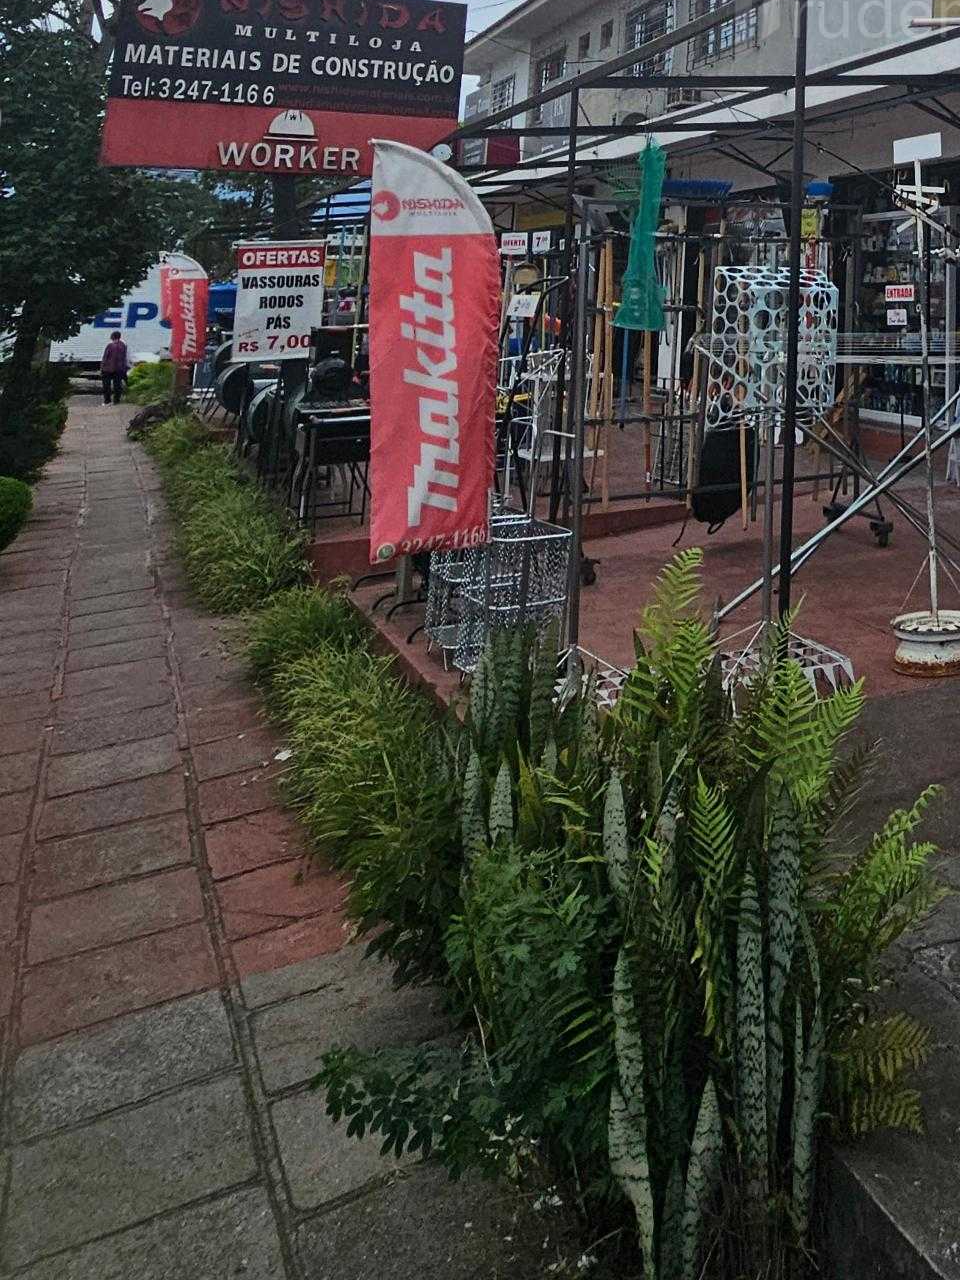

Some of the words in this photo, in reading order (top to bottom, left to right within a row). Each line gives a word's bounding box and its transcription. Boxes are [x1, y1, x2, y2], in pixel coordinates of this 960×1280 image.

[235, 24, 422, 52] MULTILOJA
[124, 43, 261, 71] MATERIAIS
[272, 52, 301, 74] DE
[311, 56, 455, 86] CONSTRUÇÃO
[218, 142, 361, 170] WORKER
[242, 250, 320, 266] OFERTAS
[241, 274, 320, 290] VASSOURAS
[259, 295, 304, 309] RODOS
[266, 314, 291, 330] PÁS
[239, 341, 259, 353] R$
[266, 334, 312, 352] 7,00
